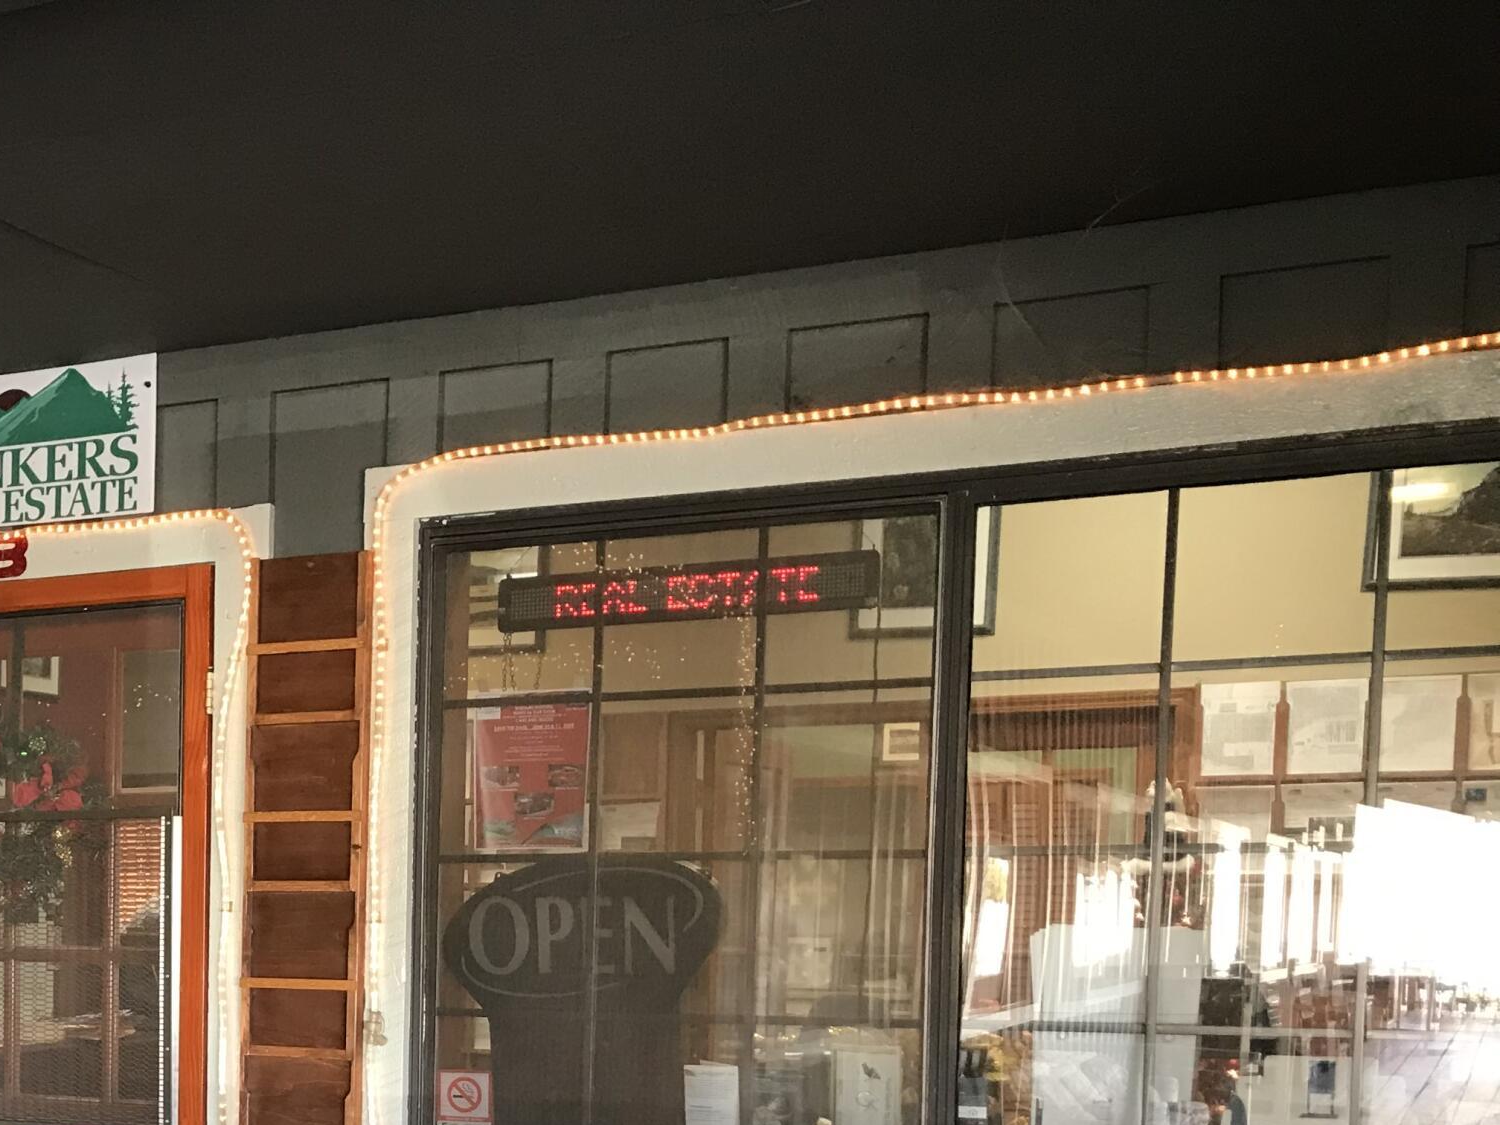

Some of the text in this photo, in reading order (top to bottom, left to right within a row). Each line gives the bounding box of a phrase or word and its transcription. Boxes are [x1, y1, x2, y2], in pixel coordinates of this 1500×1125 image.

[2, 476, 138, 524] ESTATE
[554, 580, 649, 618] REAL
[468, 895, 677, 976] OPEN
